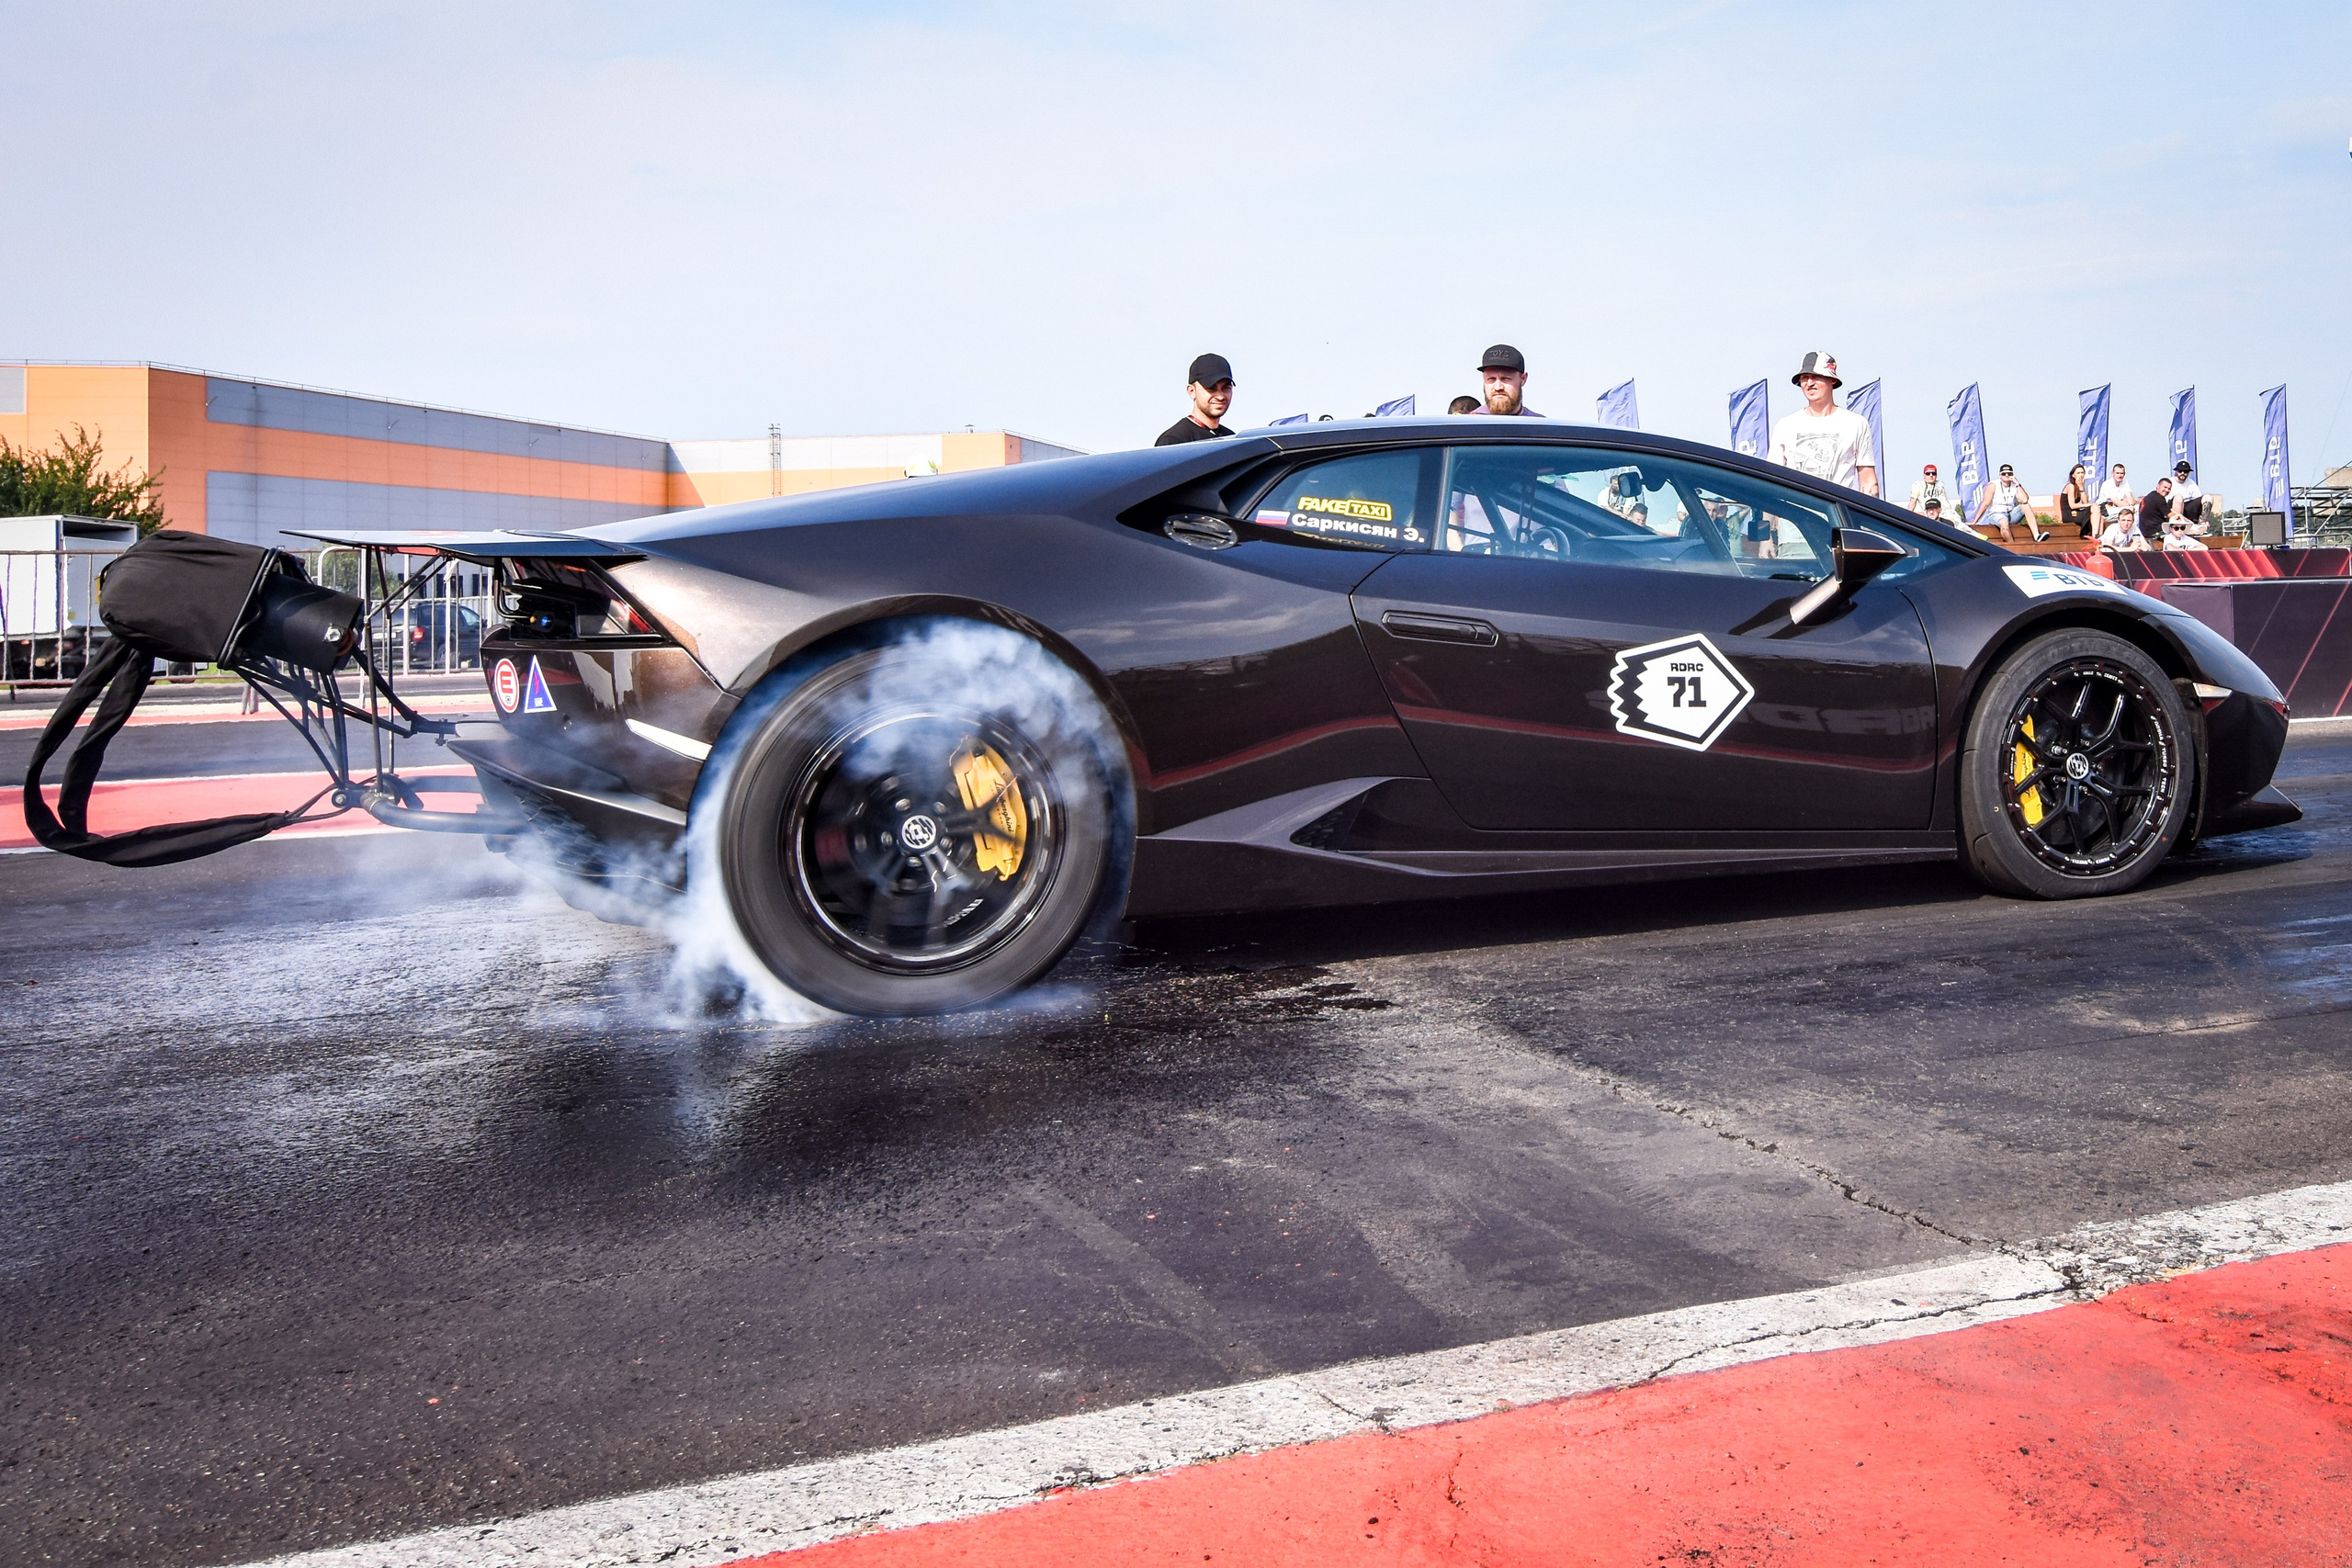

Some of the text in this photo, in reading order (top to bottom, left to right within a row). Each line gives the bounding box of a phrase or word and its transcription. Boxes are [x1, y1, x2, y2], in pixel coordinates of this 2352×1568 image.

[1488, 349, 1510, 357] TOYS
[1297, 497, 1385, 517] FAKE TAXI
[1291, 513, 1397, 538] Саркисян
[1403, 527, 1425, 543] Э.
[2053, 573, 2105, 587] ВТБ
[1670, 663, 1704, 672] RDRC
[500, 671, 514, 694] E
[1668, 676, 1707, 707] 71
